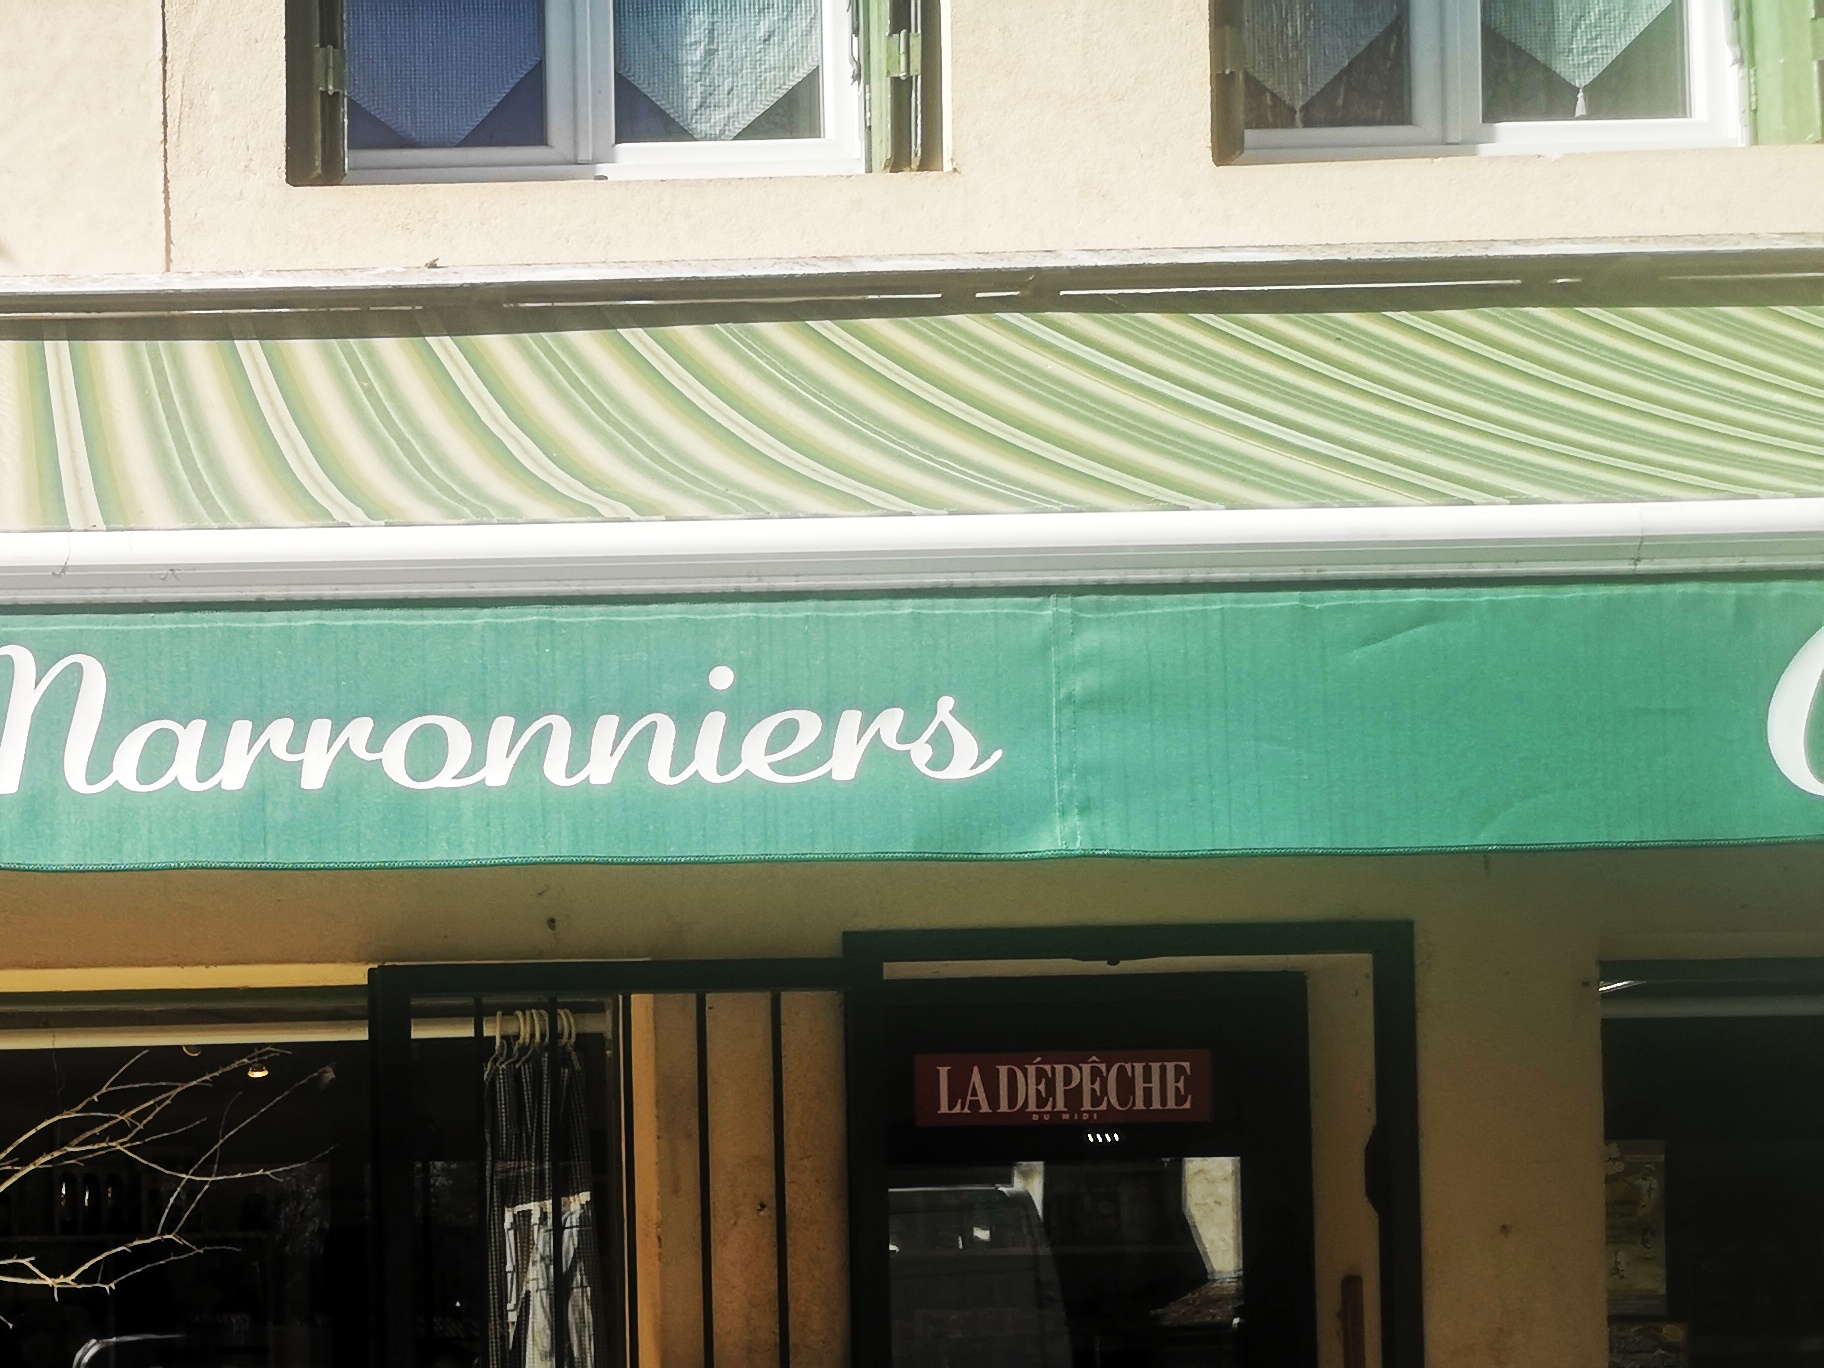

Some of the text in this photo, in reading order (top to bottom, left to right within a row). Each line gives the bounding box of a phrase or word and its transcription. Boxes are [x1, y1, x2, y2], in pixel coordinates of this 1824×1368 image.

[936, 1055, 1192, 1114] LA DÉPÊCHE
[1032, 1112, 1098, 1121] DU MIDI
